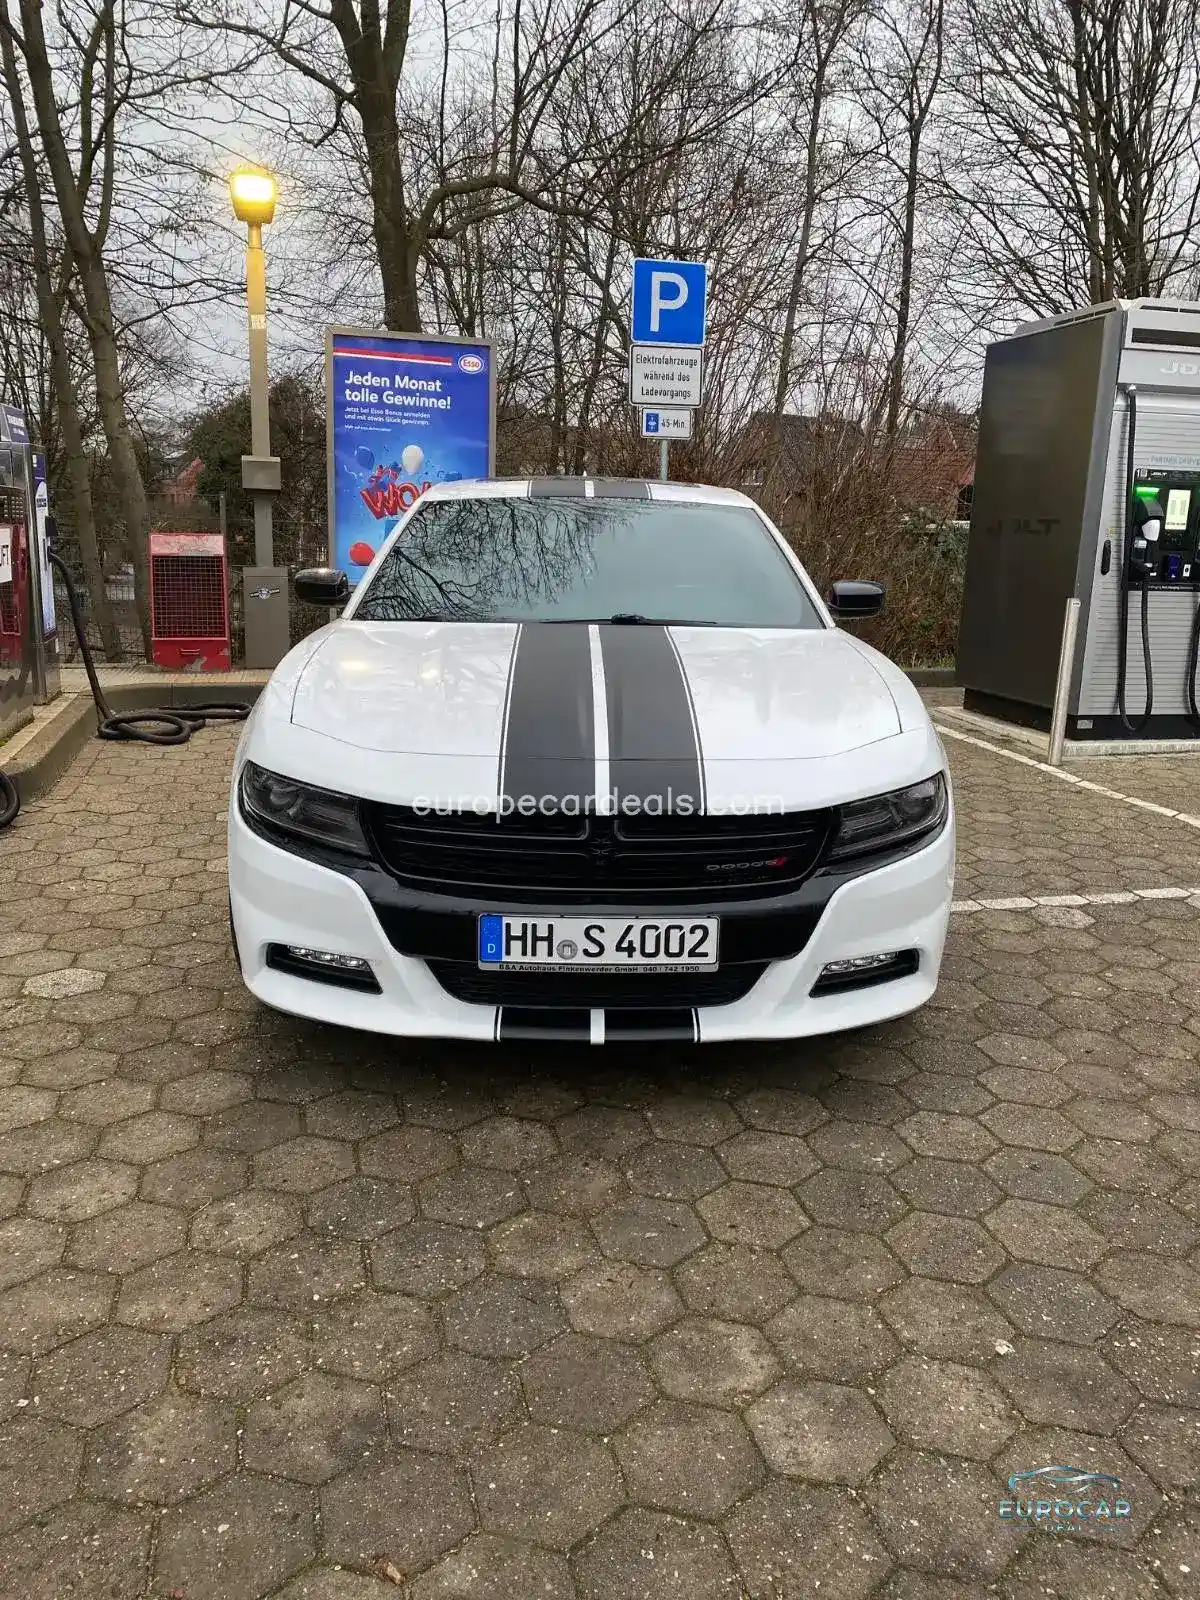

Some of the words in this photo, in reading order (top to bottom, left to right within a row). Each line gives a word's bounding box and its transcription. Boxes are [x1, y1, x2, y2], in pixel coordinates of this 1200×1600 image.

[650, 271, 689, 332] P
[636, 354, 698, 368] Elektrofahrzeuge
[345, 371, 390, 387] Jeden
[395, 375, 442, 392] Monat
[644, 370, 675, 381] während
[677, 372, 690, 381] des
[345, 388, 379, 403] tolle
[383, 391, 451, 409] Gewinne!
[641, 386, 691, 399] Ladevorgangs
[360, 481, 432, 520] WO
[706, 859, 777, 871] DODGE
[505, 922, 554, 957] HH
[583, 924, 606, 958] S
[615, 924, 709, 958] 4002
[487, 943, 496, 954] D
[499, 964, 517, 972] B&A
[559, 965, 613, 973] Finkenwerder
